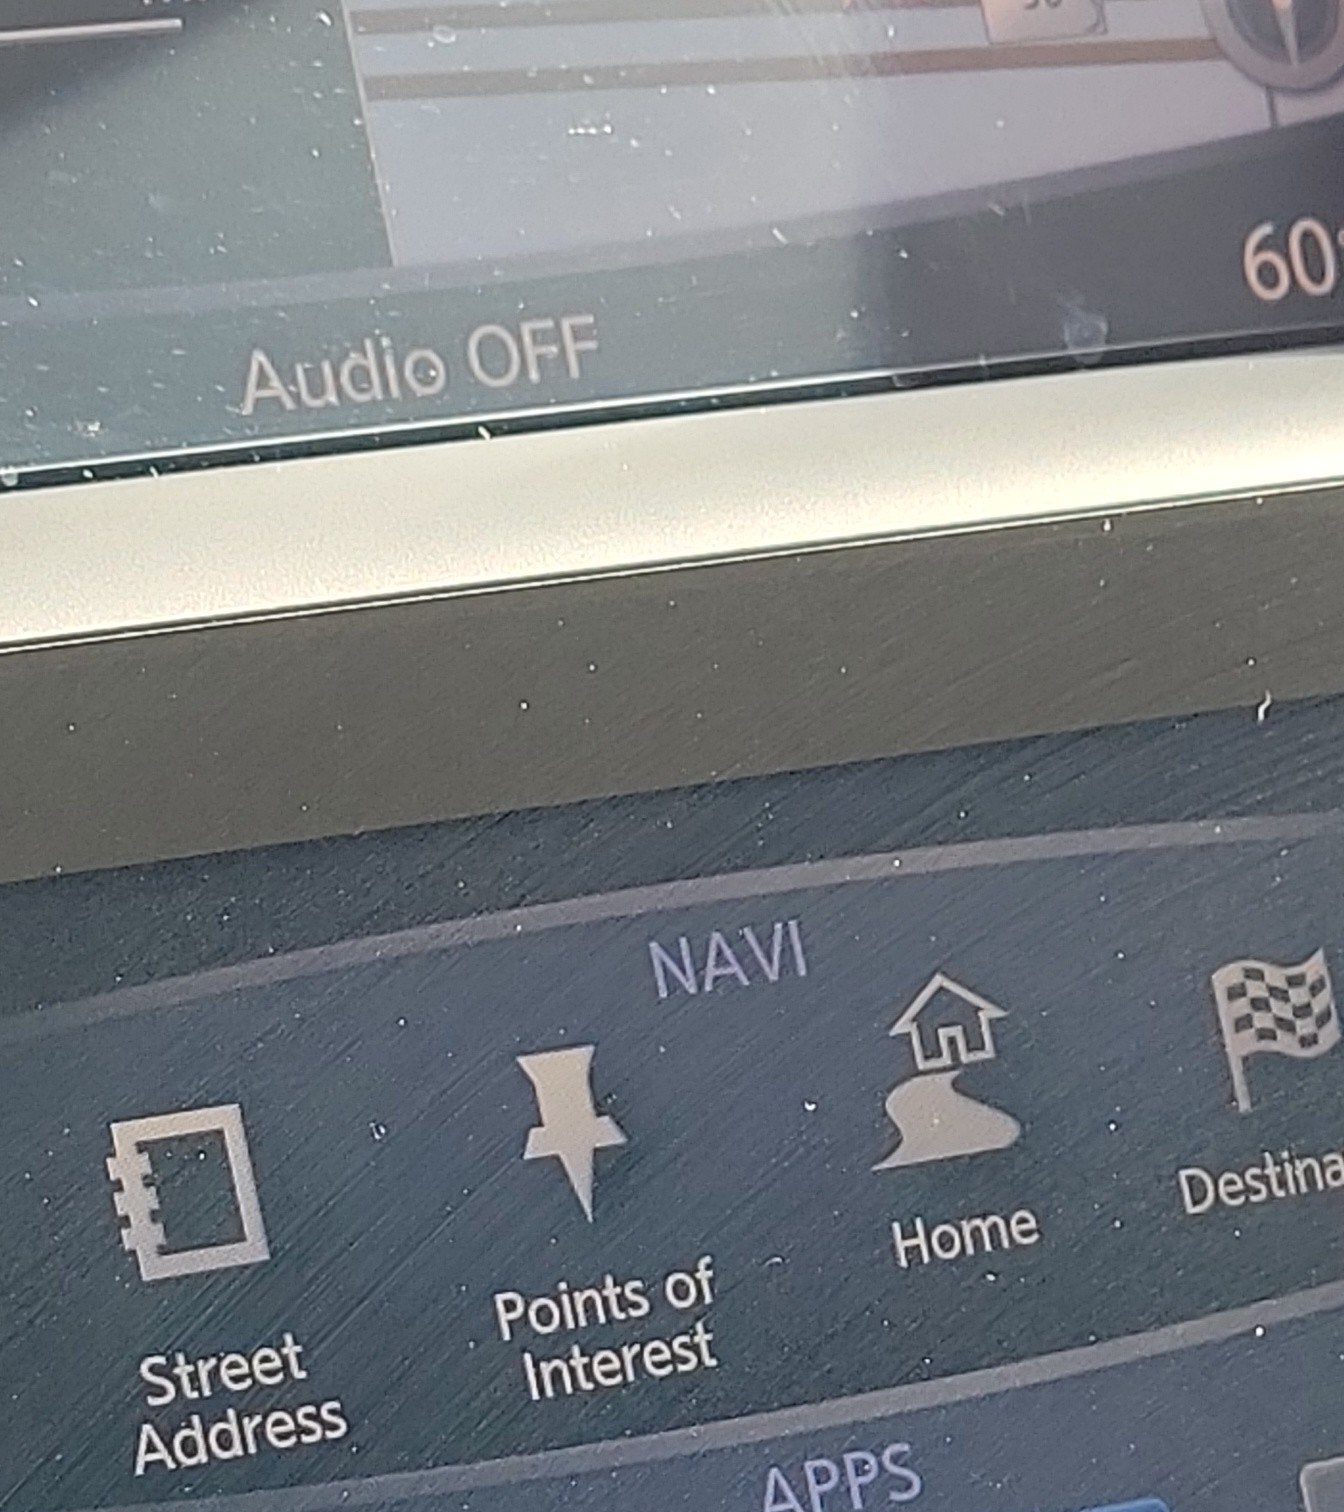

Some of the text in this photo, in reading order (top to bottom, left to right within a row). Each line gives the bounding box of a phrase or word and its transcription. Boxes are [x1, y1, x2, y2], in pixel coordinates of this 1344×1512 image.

[241, 314, 600, 415] Audio OFF
[648, 920, 808, 999] NAVI
[891, 1210, 1041, 1268] Home
[494, 1257, 716, 1341] Points of
[138, 1333, 308, 1406] Street
[523, 1324, 718, 1401] Interest
[133, 1400, 349, 1476] Address
